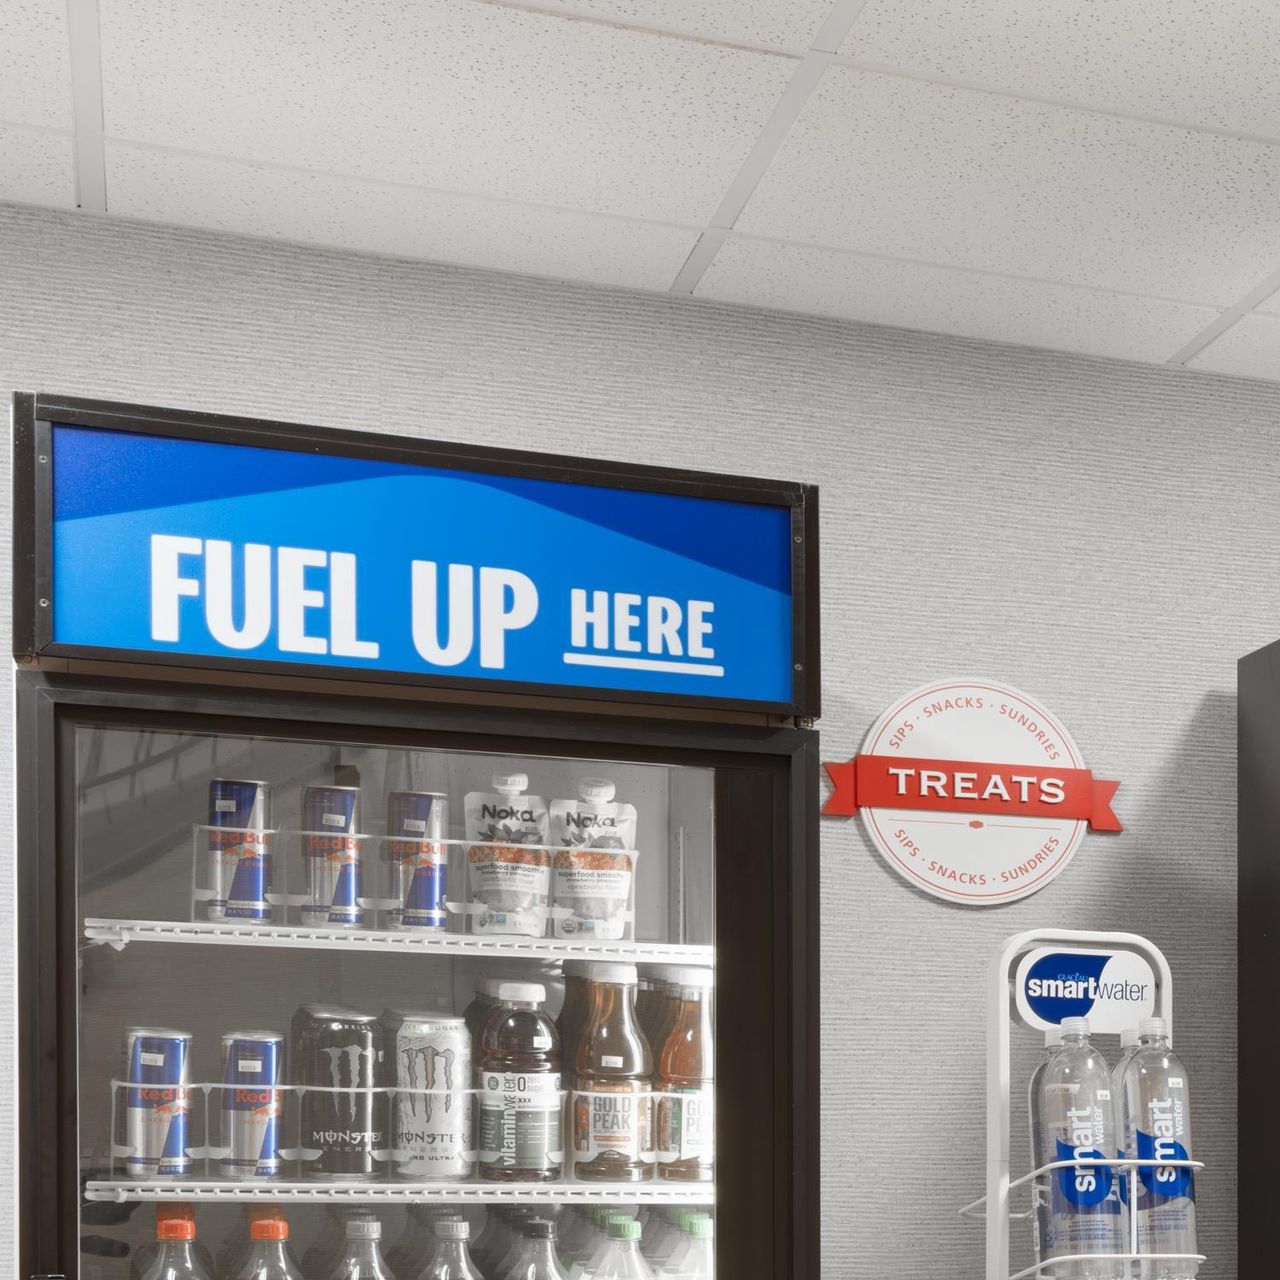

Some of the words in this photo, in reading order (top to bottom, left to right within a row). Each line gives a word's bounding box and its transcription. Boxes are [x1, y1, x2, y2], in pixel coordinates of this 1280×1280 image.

[151, 534, 378, 659] FUEL
[411, 561, 539, 669] UP
[570, 588, 714, 658] HERE
[888, 720, 914, 749] SIPS
[923, 697, 983, 717] SNACKS
[999, 703, 1060, 760] SUNDRIES
[888, 767, 1065, 804] TREATS
[481, 804, 536, 823] Noka
[566, 811, 617, 828] Noka
[893, 828, 920, 857] SIPS
[928, 861, 987, 885] SNACKS
[1000, 836, 1060, 882] SUNDRIES
[501, 1070, 516, 1166] vitaminwater
[593, 1096, 631, 1112] GOLD
[593, 1113, 630, 1130] PEAK
[1067, 1106, 1096, 1193] smart
